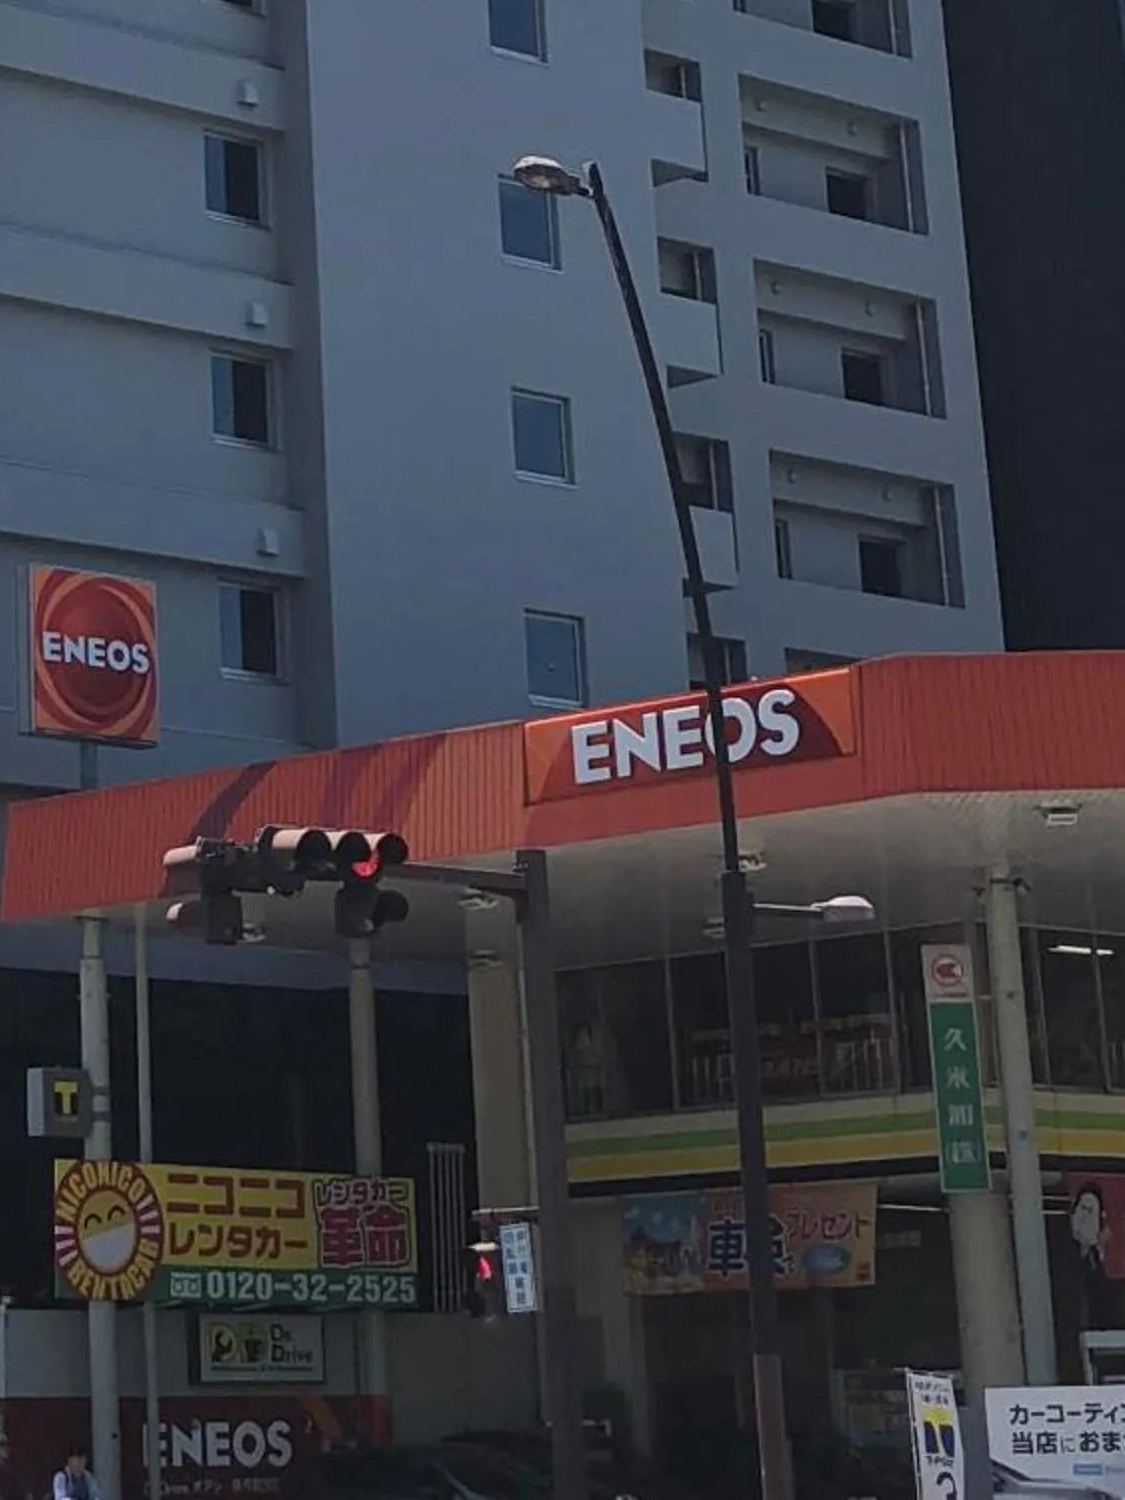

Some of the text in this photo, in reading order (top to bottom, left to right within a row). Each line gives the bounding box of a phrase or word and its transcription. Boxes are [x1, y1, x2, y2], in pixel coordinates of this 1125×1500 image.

[41, 631, 151, 675] ENEOS
[571, 688, 801, 786] ENEOS
[55, 1160, 148, 1225] NICONICO
[166, 1172, 306, 1219] ニコニコ
[313, 1178, 410, 1206] レンタカー
[169, 1221, 308, 1260] レンタカー
[321, 1203, 411, 1267] 革命
[206, 1270, 417, 1304] 0120-32-2525
[271, 1345, 315, 1364] Drive
[142, 1418, 293, 1468] ENEOS
[1012, 1431, 1125, 1455] 当店におま
